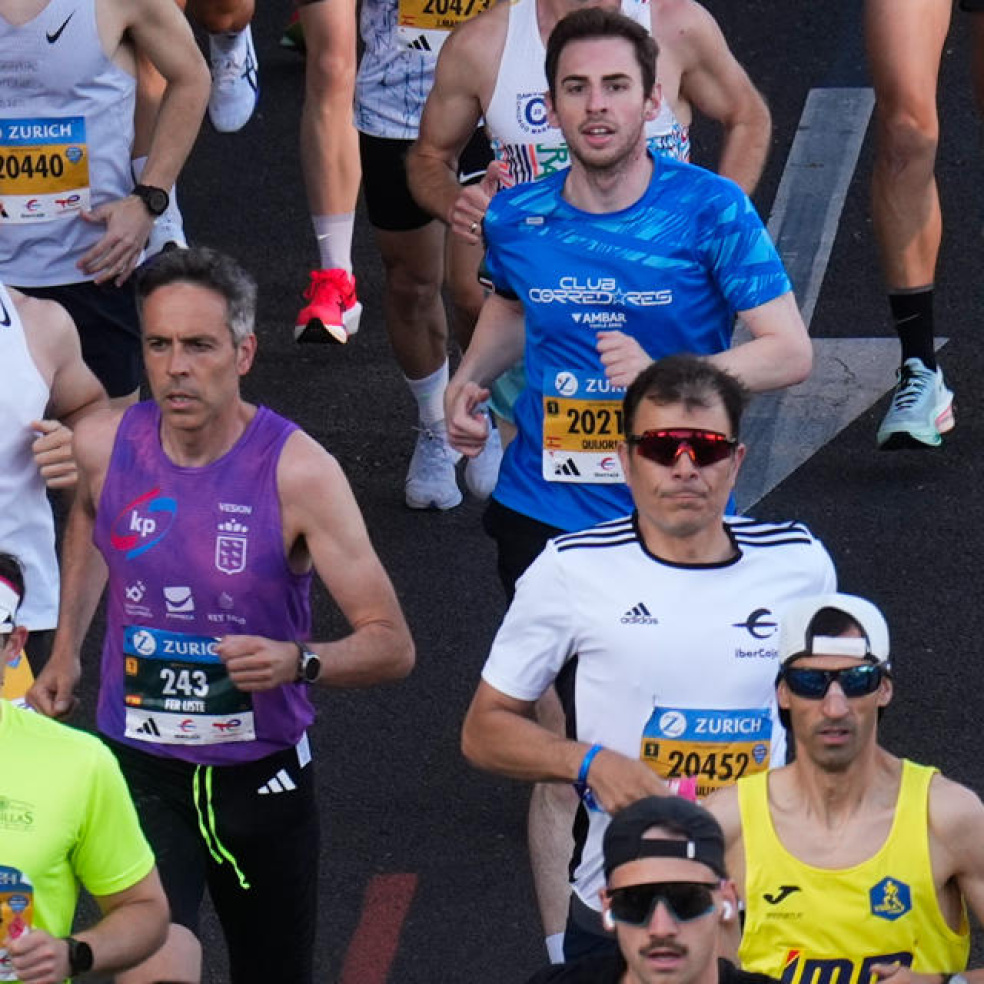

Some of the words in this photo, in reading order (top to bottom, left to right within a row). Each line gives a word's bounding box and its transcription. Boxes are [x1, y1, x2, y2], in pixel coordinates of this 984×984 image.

[7, 122, 73, 141] ZURICH
[559, 277, 617, 292] CLUB
[582, 312, 628, 325] AMBAR
[566, 407, 625, 436] 2021
[131, 510, 157, 537] kp
[163, 640, 219, 657] ZURIC
[160, 668, 210, 697] 243
[694, 717, 763, 735] ZURICH
[667, 750, 750, 782] 20452
